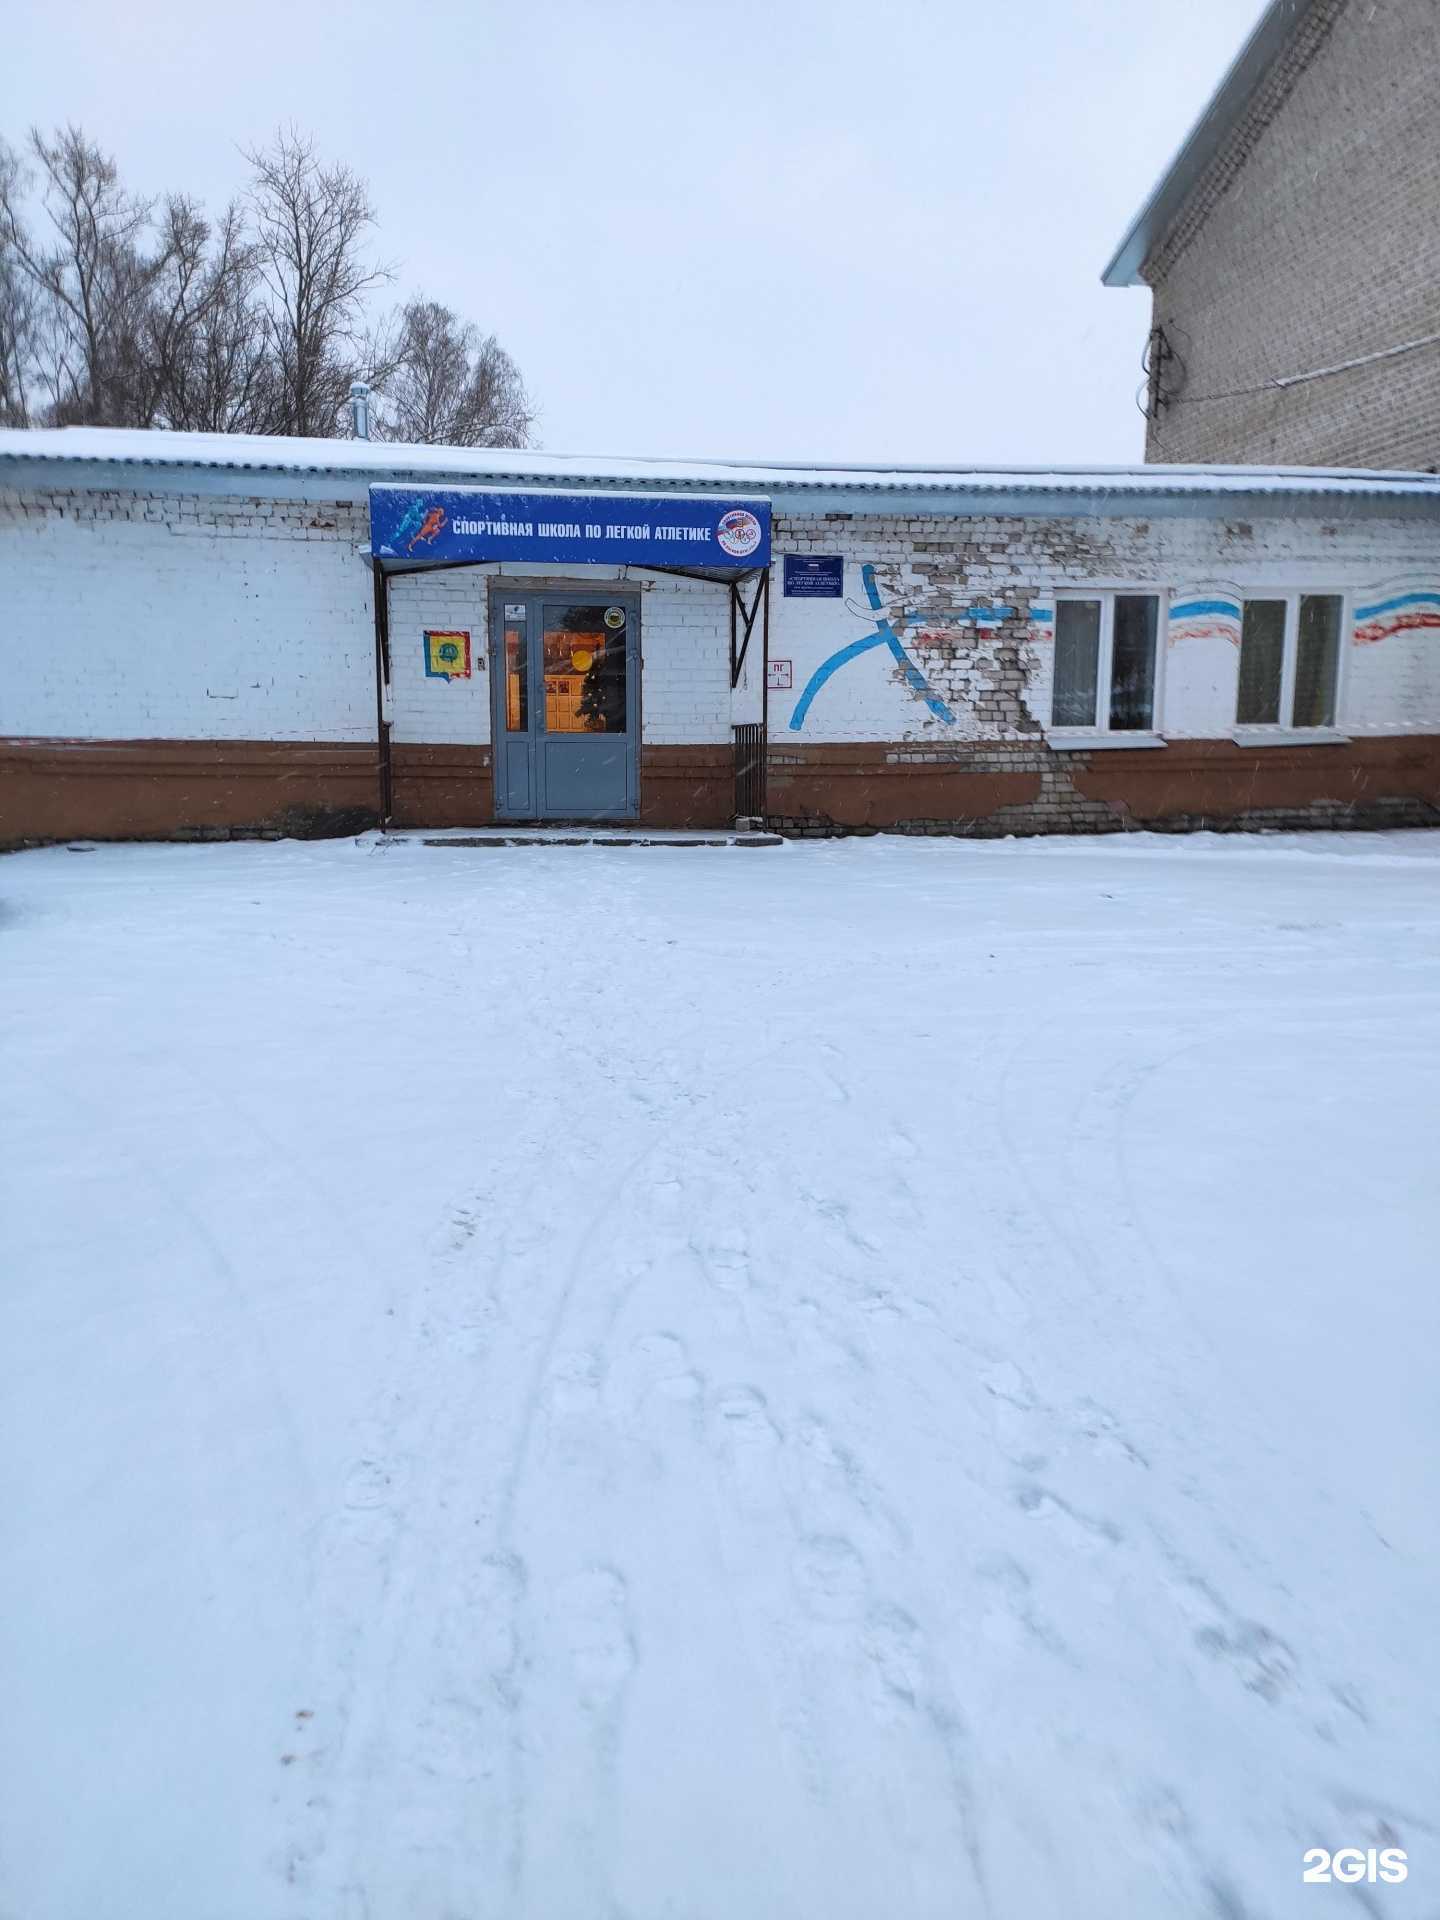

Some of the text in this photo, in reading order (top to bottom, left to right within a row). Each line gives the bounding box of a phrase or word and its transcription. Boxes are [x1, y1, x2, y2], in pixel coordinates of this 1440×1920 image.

[452, 520, 712, 541] СПОРТИВНАЯ ШКОЛА ПО ЛЕГКОЙ АТЛЕТИКЕ
